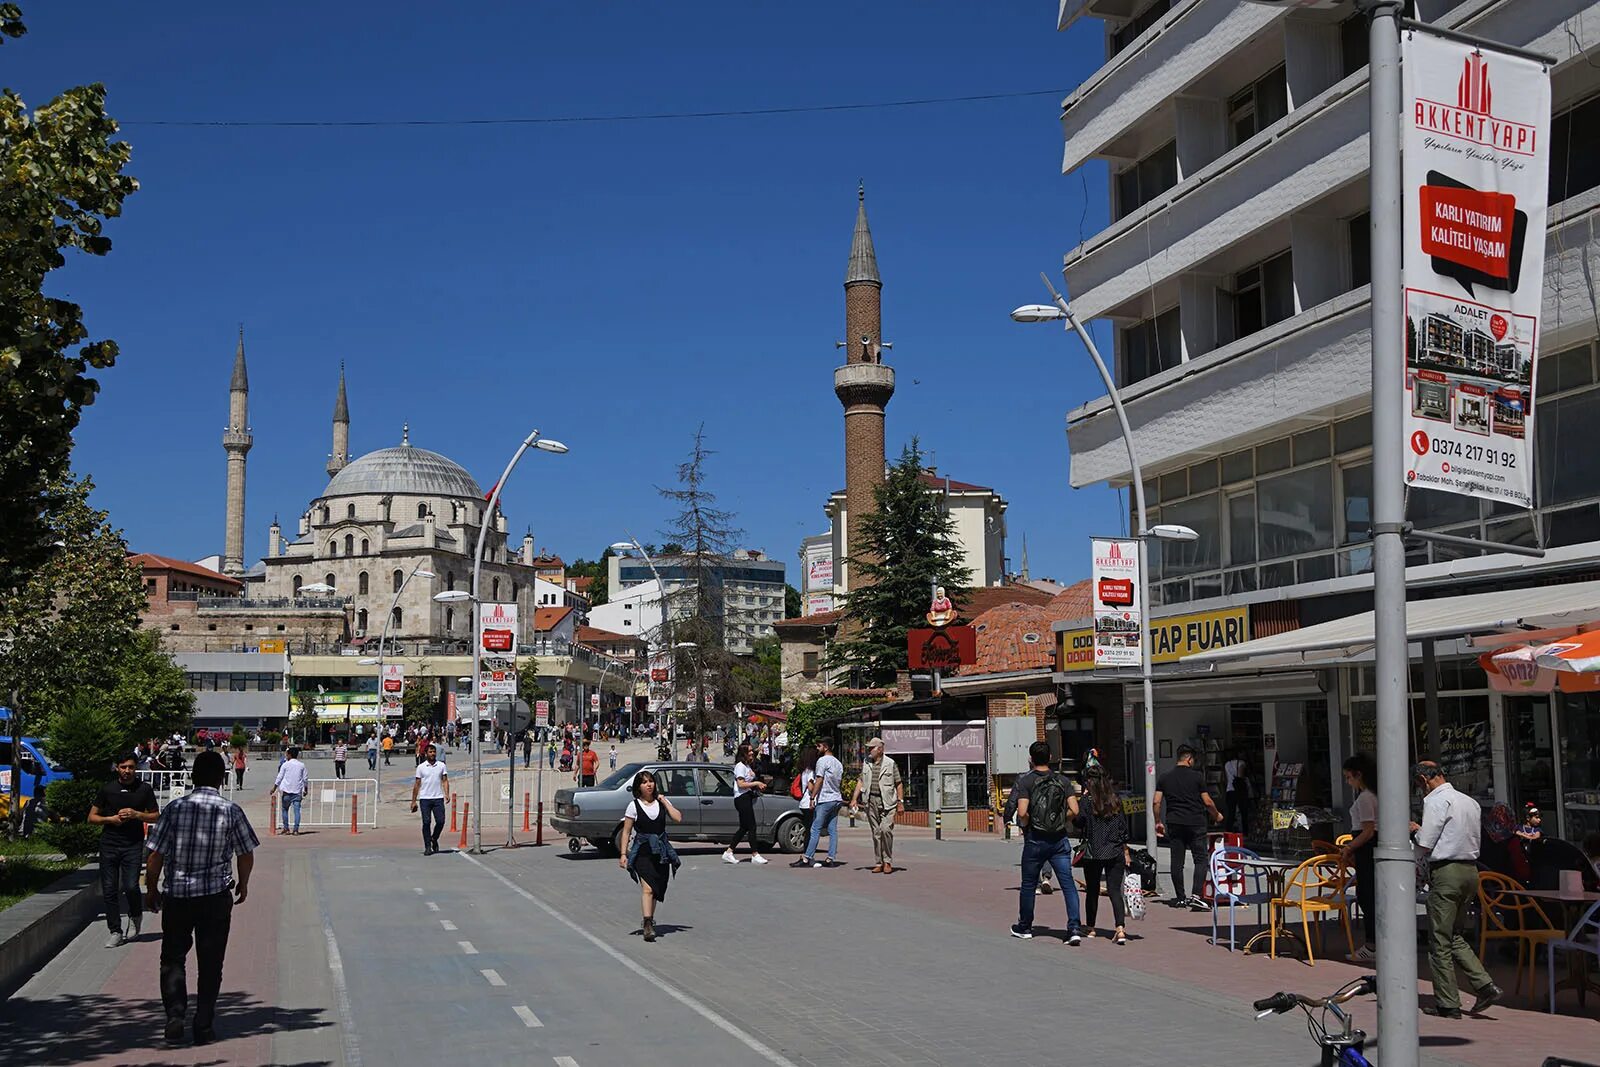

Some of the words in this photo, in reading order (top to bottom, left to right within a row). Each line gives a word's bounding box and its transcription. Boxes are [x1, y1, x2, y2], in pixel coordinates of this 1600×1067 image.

[1435, 202, 1463, 222] KARLI
[1464, 209, 1502, 233] YATIRIM
[1431, 226, 1471, 250] KALİTELİ
[1473, 236, 1505, 259] YAŞAM
[1454, 304, 1488, 320] ADALET
[1432, 438, 1462, 457] 0374
[1465, 444, 1483, 461] 217
[1486, 448, 1498, 464] 91
[1501, 452, 1516, 468] 92
[1186, 616, 1244, 651] FUARI
